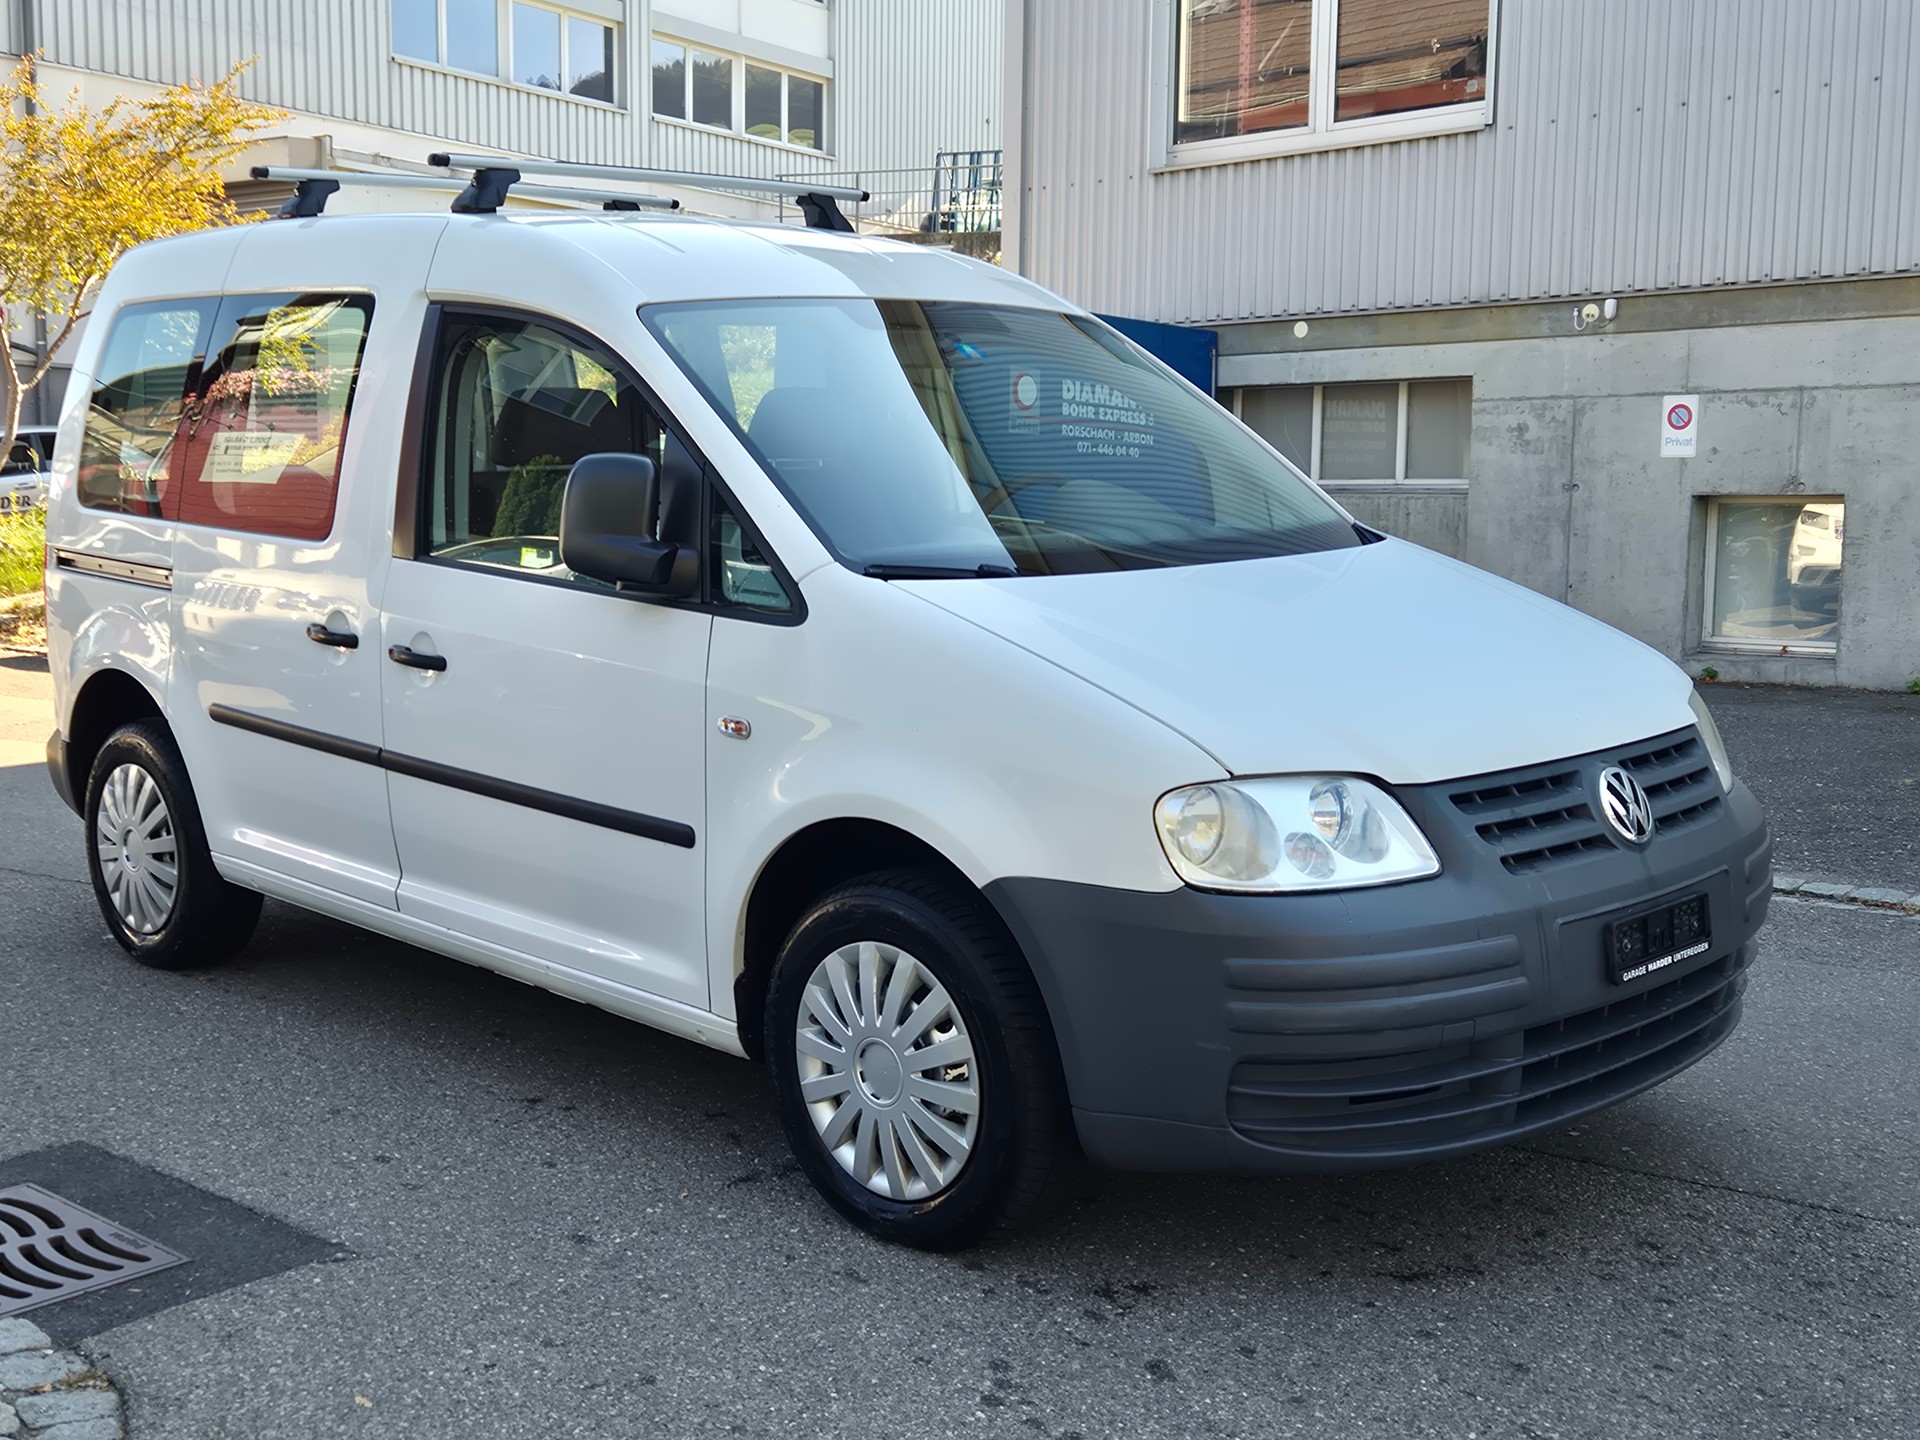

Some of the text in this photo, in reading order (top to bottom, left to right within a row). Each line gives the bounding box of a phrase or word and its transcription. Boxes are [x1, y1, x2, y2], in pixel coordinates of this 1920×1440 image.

[1062, 379, 1142, 409] DIAMAN
[1062, 402, 1095, 419] BOHR
[1099, 407, 1146, 425] EXPRESS
[1062, 424, 1115, 441] RORSCHACH
[1123, 431, 1154, 446] ARBON
[1665, 437, 1693, 446] Privat
[1116, 445, 1127, 456] 04
[1128, 446, 1140, 458] 40
[1599, 767, 1652, 843] VW
[1623, 942, 1709, 981] GARAGE HARDER UNTEREGGEN
